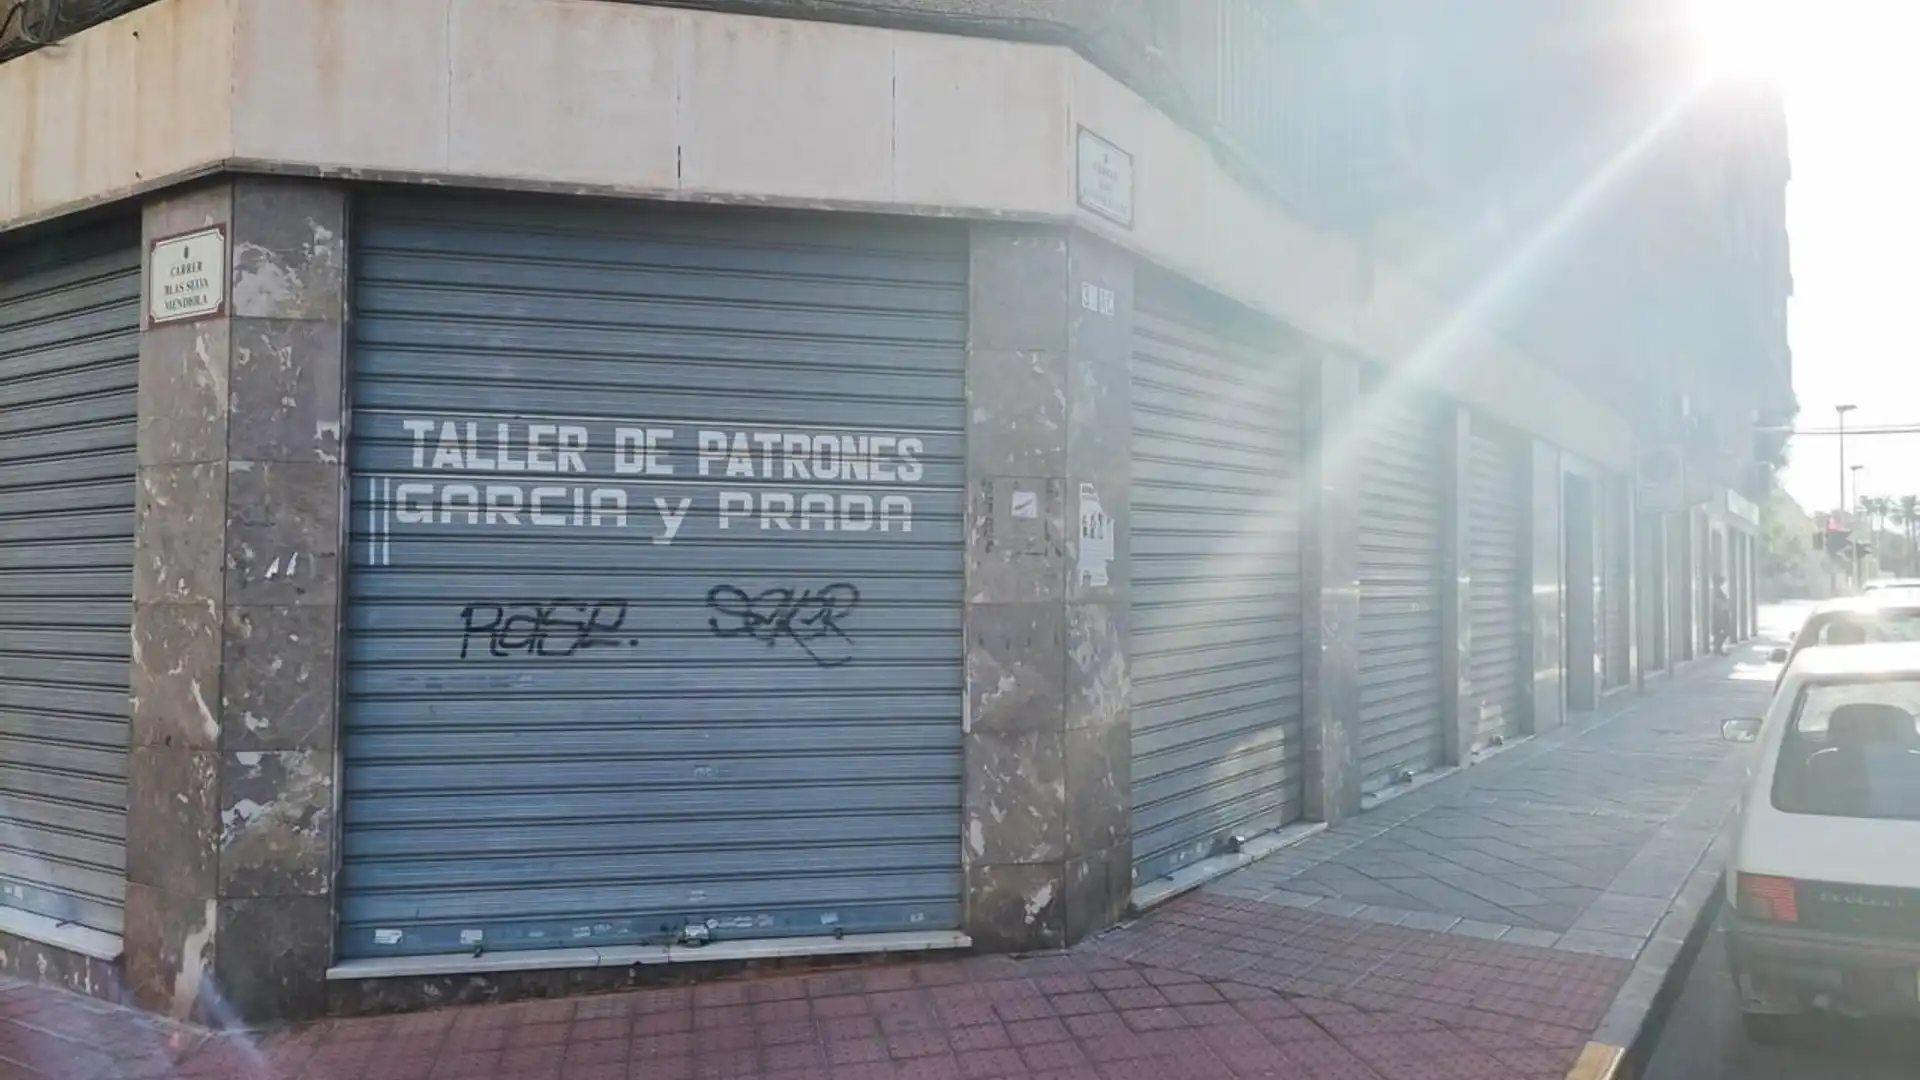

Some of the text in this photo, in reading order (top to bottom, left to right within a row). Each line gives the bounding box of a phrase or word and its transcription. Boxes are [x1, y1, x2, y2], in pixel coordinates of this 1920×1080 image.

[170, 261, 203, 277] CARRER
[403, 420, 923, 482] TALLER DE PATRONES
[396, 484, 912, 544] GARCIA y PRADA
